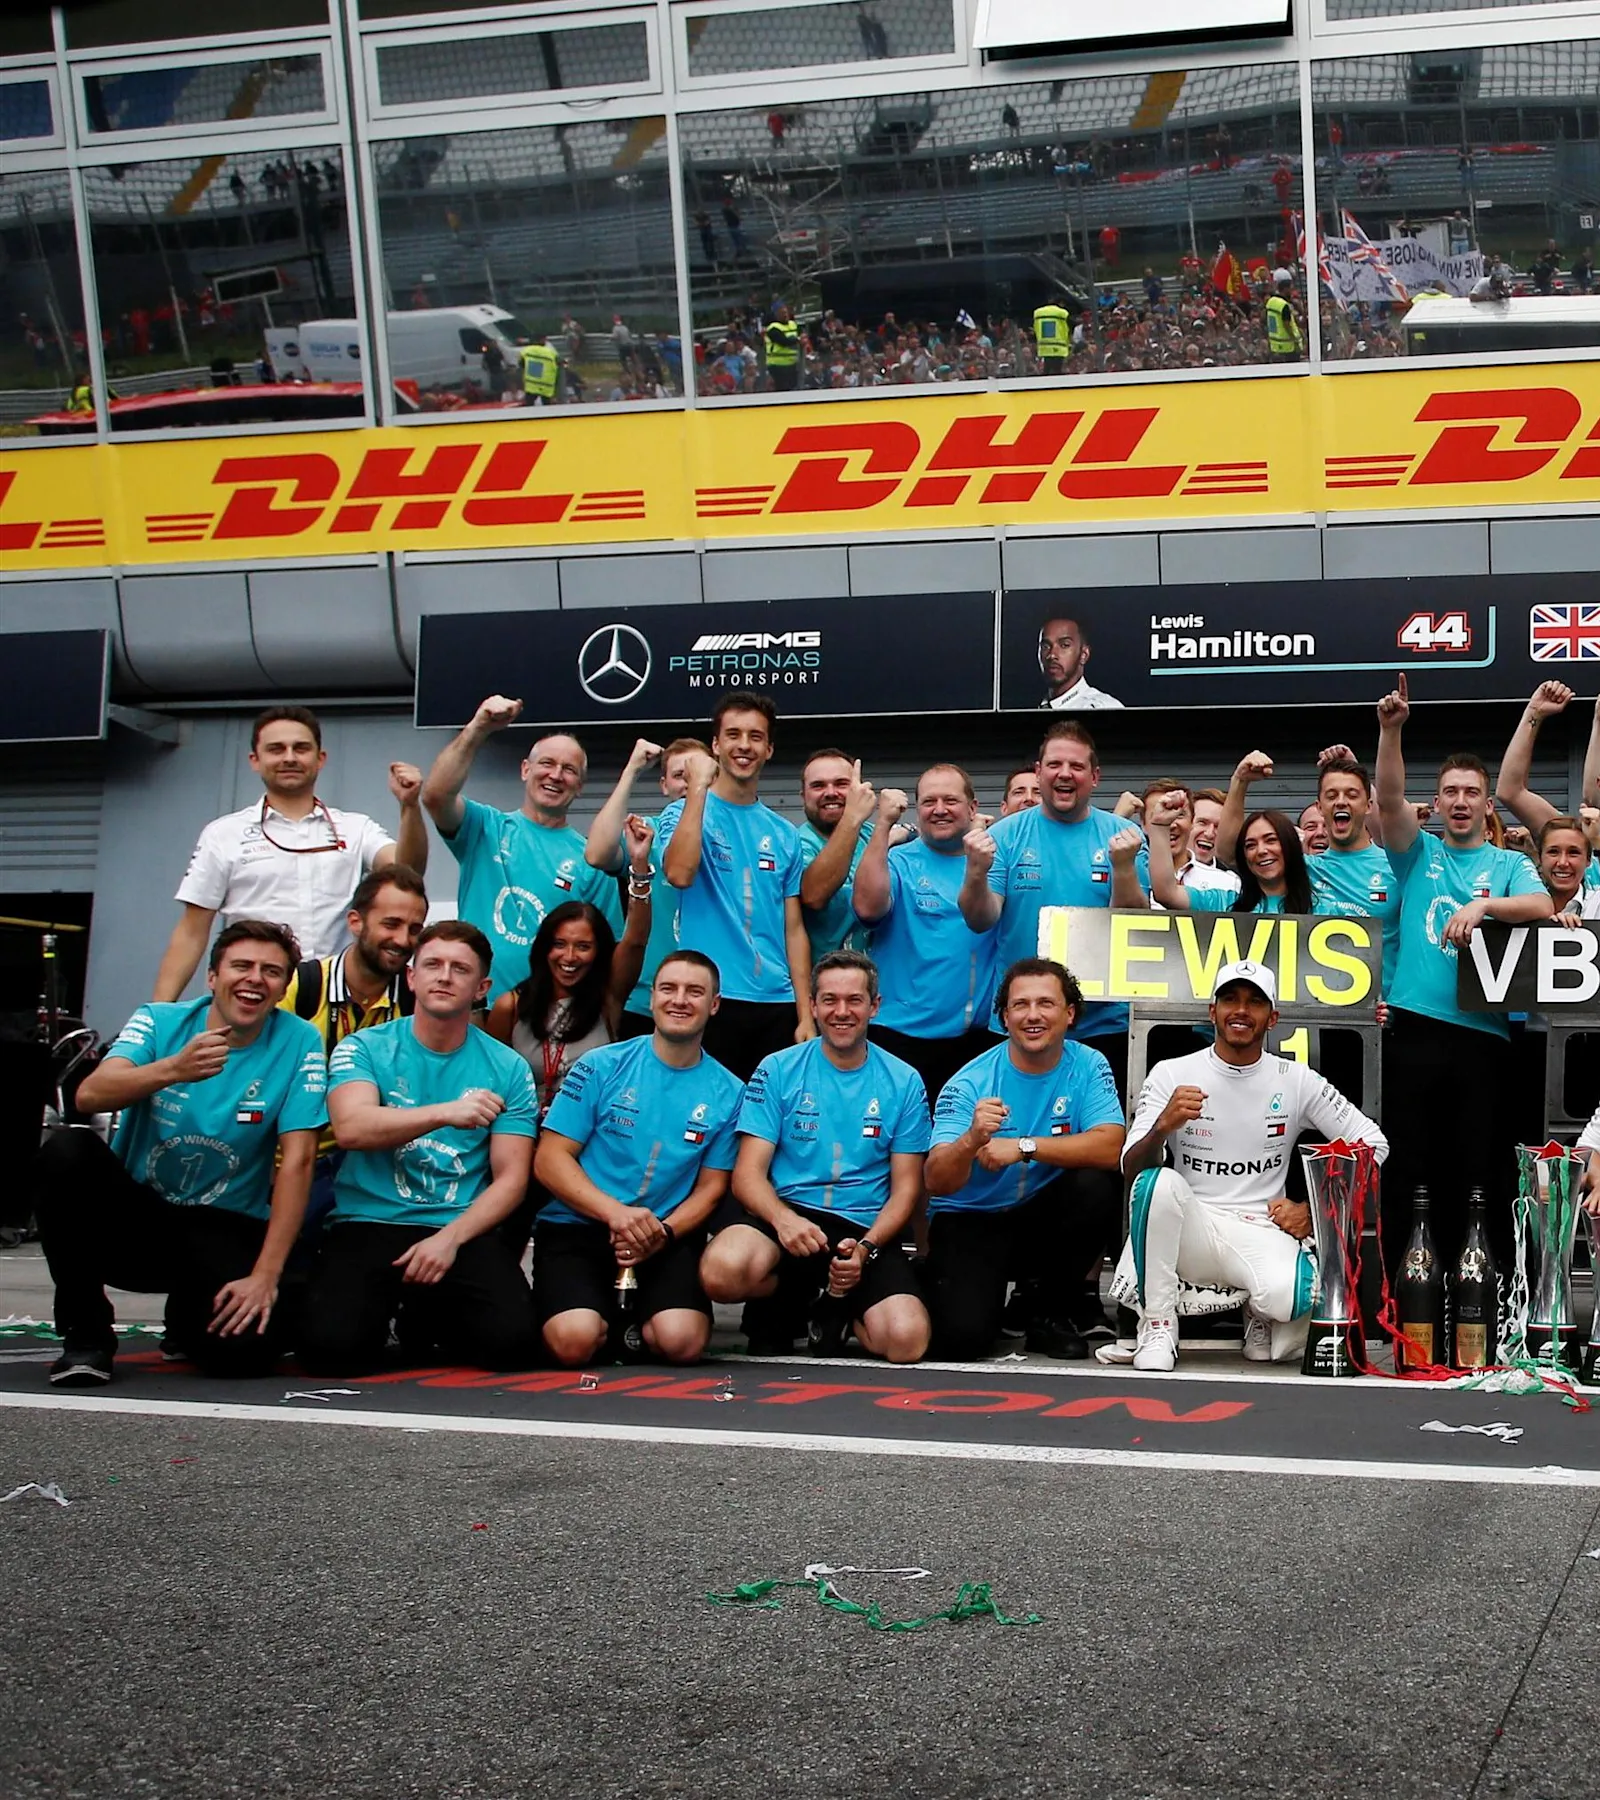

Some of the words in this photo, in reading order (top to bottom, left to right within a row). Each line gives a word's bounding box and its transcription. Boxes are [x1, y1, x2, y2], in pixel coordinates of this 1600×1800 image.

[770, 407, 1188, 514] DHL
[210, 440, 574, 539] DHL
[1151, 614, 1204, 630] Lewis
[1397, 611, 1471, 653] 44
[732, 631, 821, 650] AMG
[1151, 630, 1316, 661] Hamilton
[670, 651, 820, 673] PETRONAS
[690, 671, 820, 688] MOTORSPORT
[505, 932, 527, 946] 2018
[1050, 912, 1372, 1007] LEWIS
[1470, 927, 1600, 1003] VB
[1280, 1027, 1309, 1064] 1
[575, 1062, 594, 1075] PSON
[1195, 1128, 1213, 1138] UBS
[184, 1134, 232, 1157] WINNERS
[180, 1152, 204, 1194] 1
[1183, 1154, 1282, 1176] PETRONAS
[1413, 1250, 1424, 1264] 3
[1175, 1298, 1248, 1315] rcedes-A
[325, 1366, 1254, 1423] MILTON
